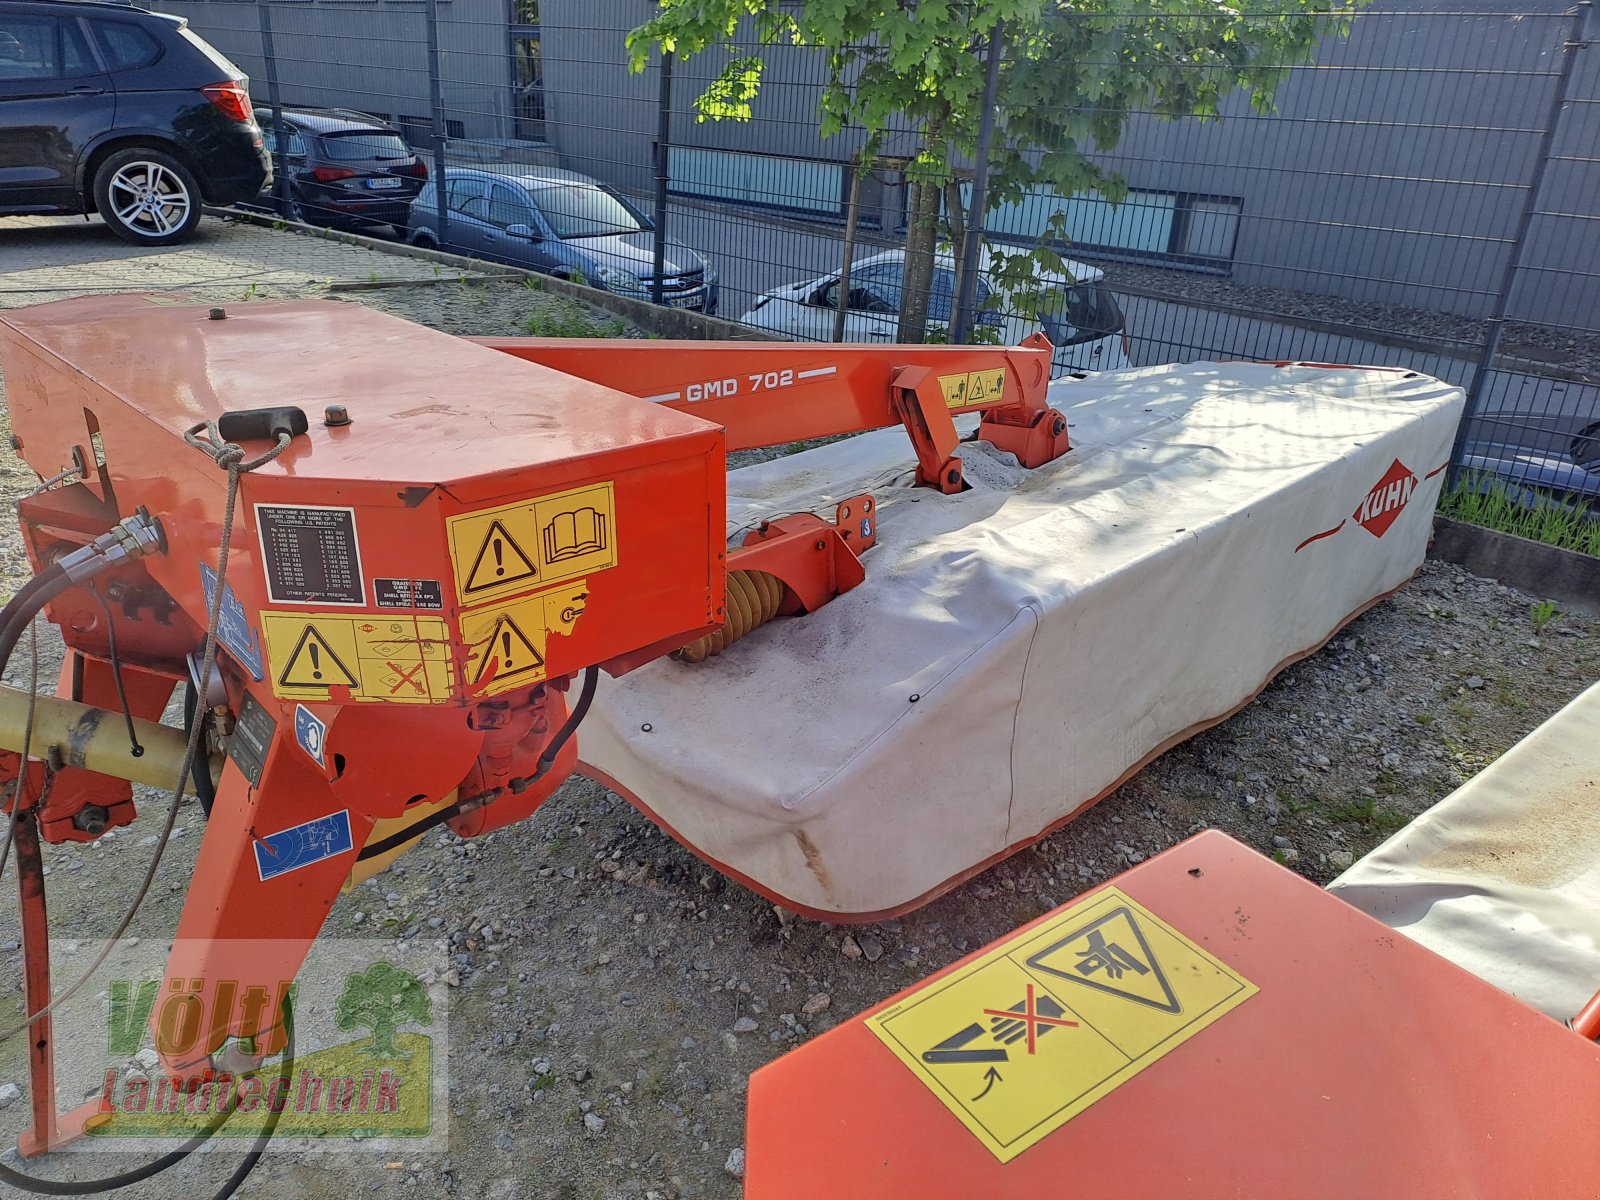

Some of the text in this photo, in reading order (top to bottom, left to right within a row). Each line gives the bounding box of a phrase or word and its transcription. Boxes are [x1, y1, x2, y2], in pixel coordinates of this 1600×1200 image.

[686, 370, 793, 402] GMD 702
[1359, 474, 1414, 525] KUHN
